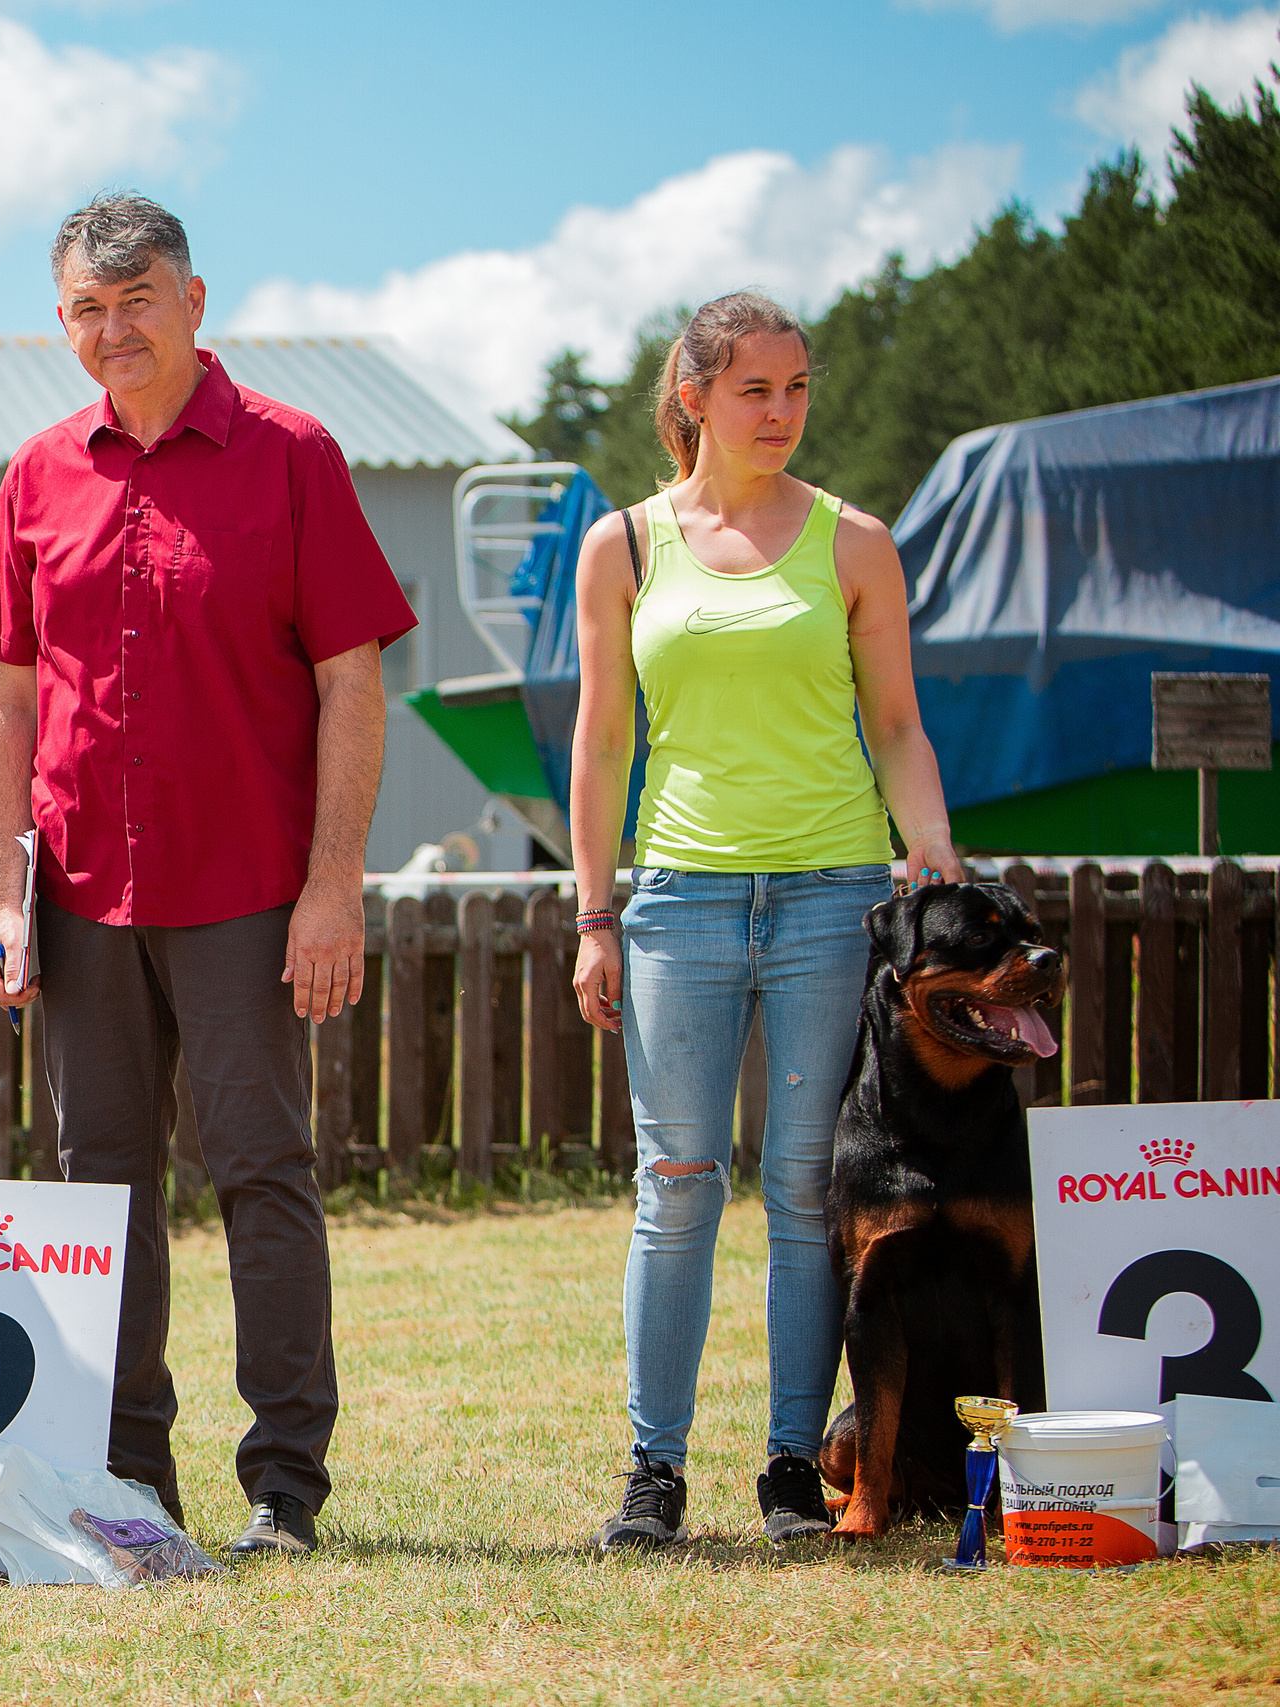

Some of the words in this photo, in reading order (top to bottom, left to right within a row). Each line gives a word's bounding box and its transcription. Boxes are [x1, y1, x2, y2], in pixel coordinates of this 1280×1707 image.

[1057, 1171, 1167, 1204] ROYAL
[1173, 1166, 1280, 1199] CANIN
[1097, 1248, 1277, 1405] 3
[1057, 1484, 1114, 1498] ПОДХОД
[1006, 1498, 1035, 1511] ВАШИХ
